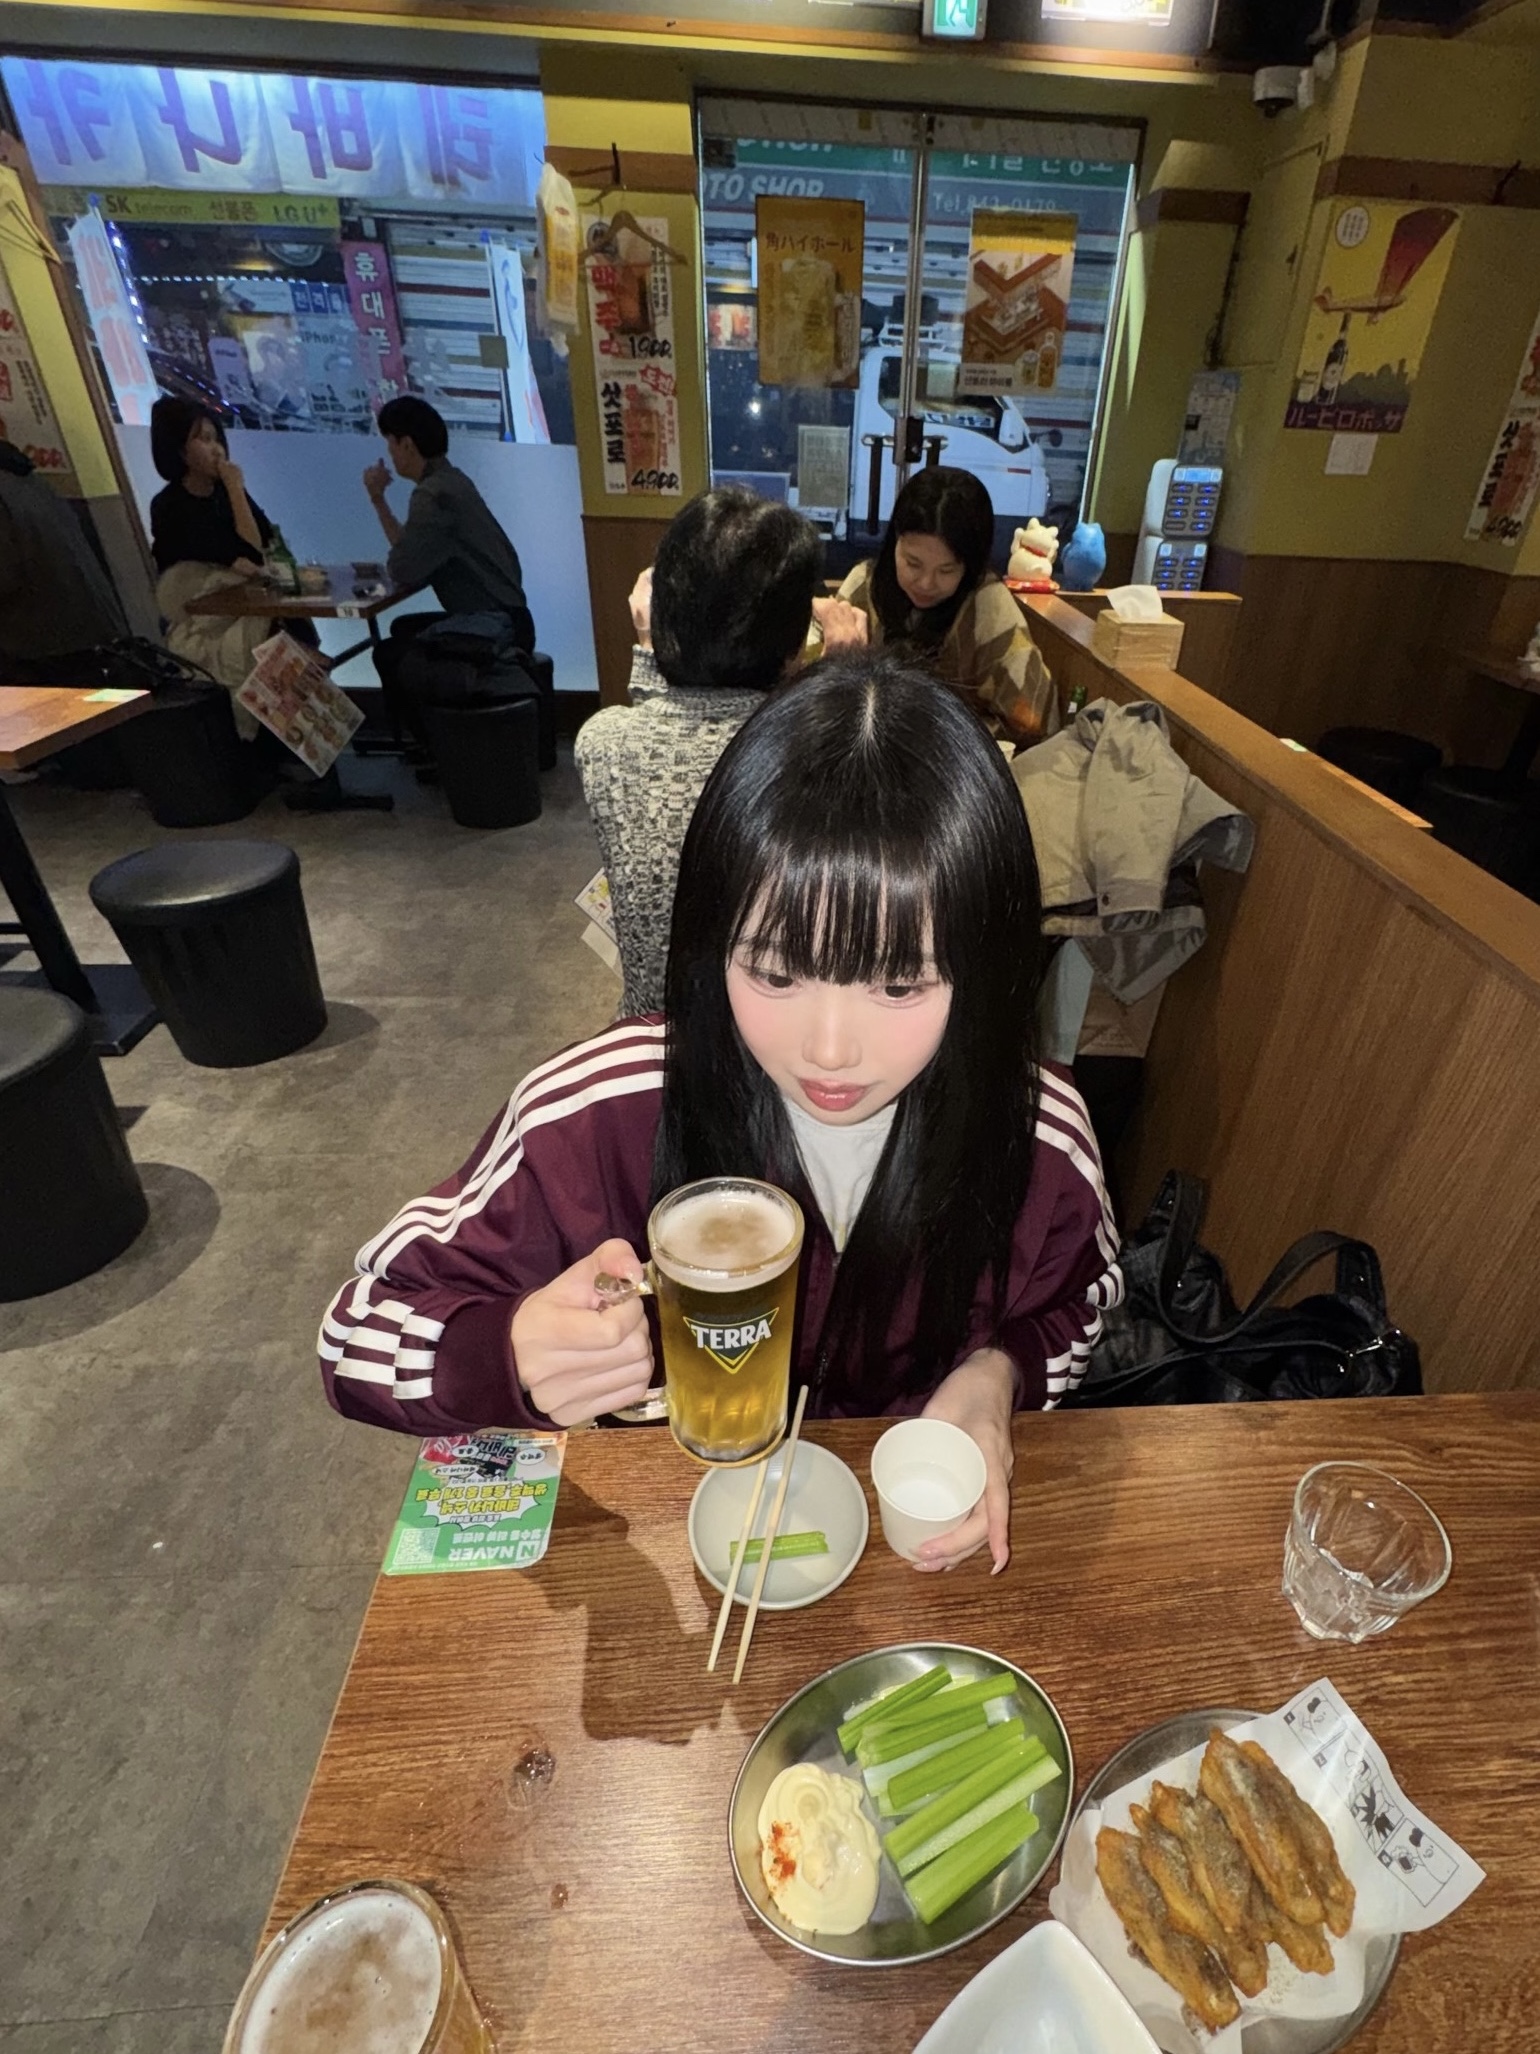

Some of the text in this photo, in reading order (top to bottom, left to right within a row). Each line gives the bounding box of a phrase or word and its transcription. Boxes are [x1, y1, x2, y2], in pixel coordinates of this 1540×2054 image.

[748, 174, 824, 203] SHOP
[105, 196, 132, 215] SK
[601, 381, 627, 464] 삿포로
[690, 1319, 773, 1350] TERRA
[415, 1488, 441, 1502] 무료
[452, 1528, 542, 1544] 영수증 리뷰 이벤트
[448, 1544, 516, 1562] NAVER
